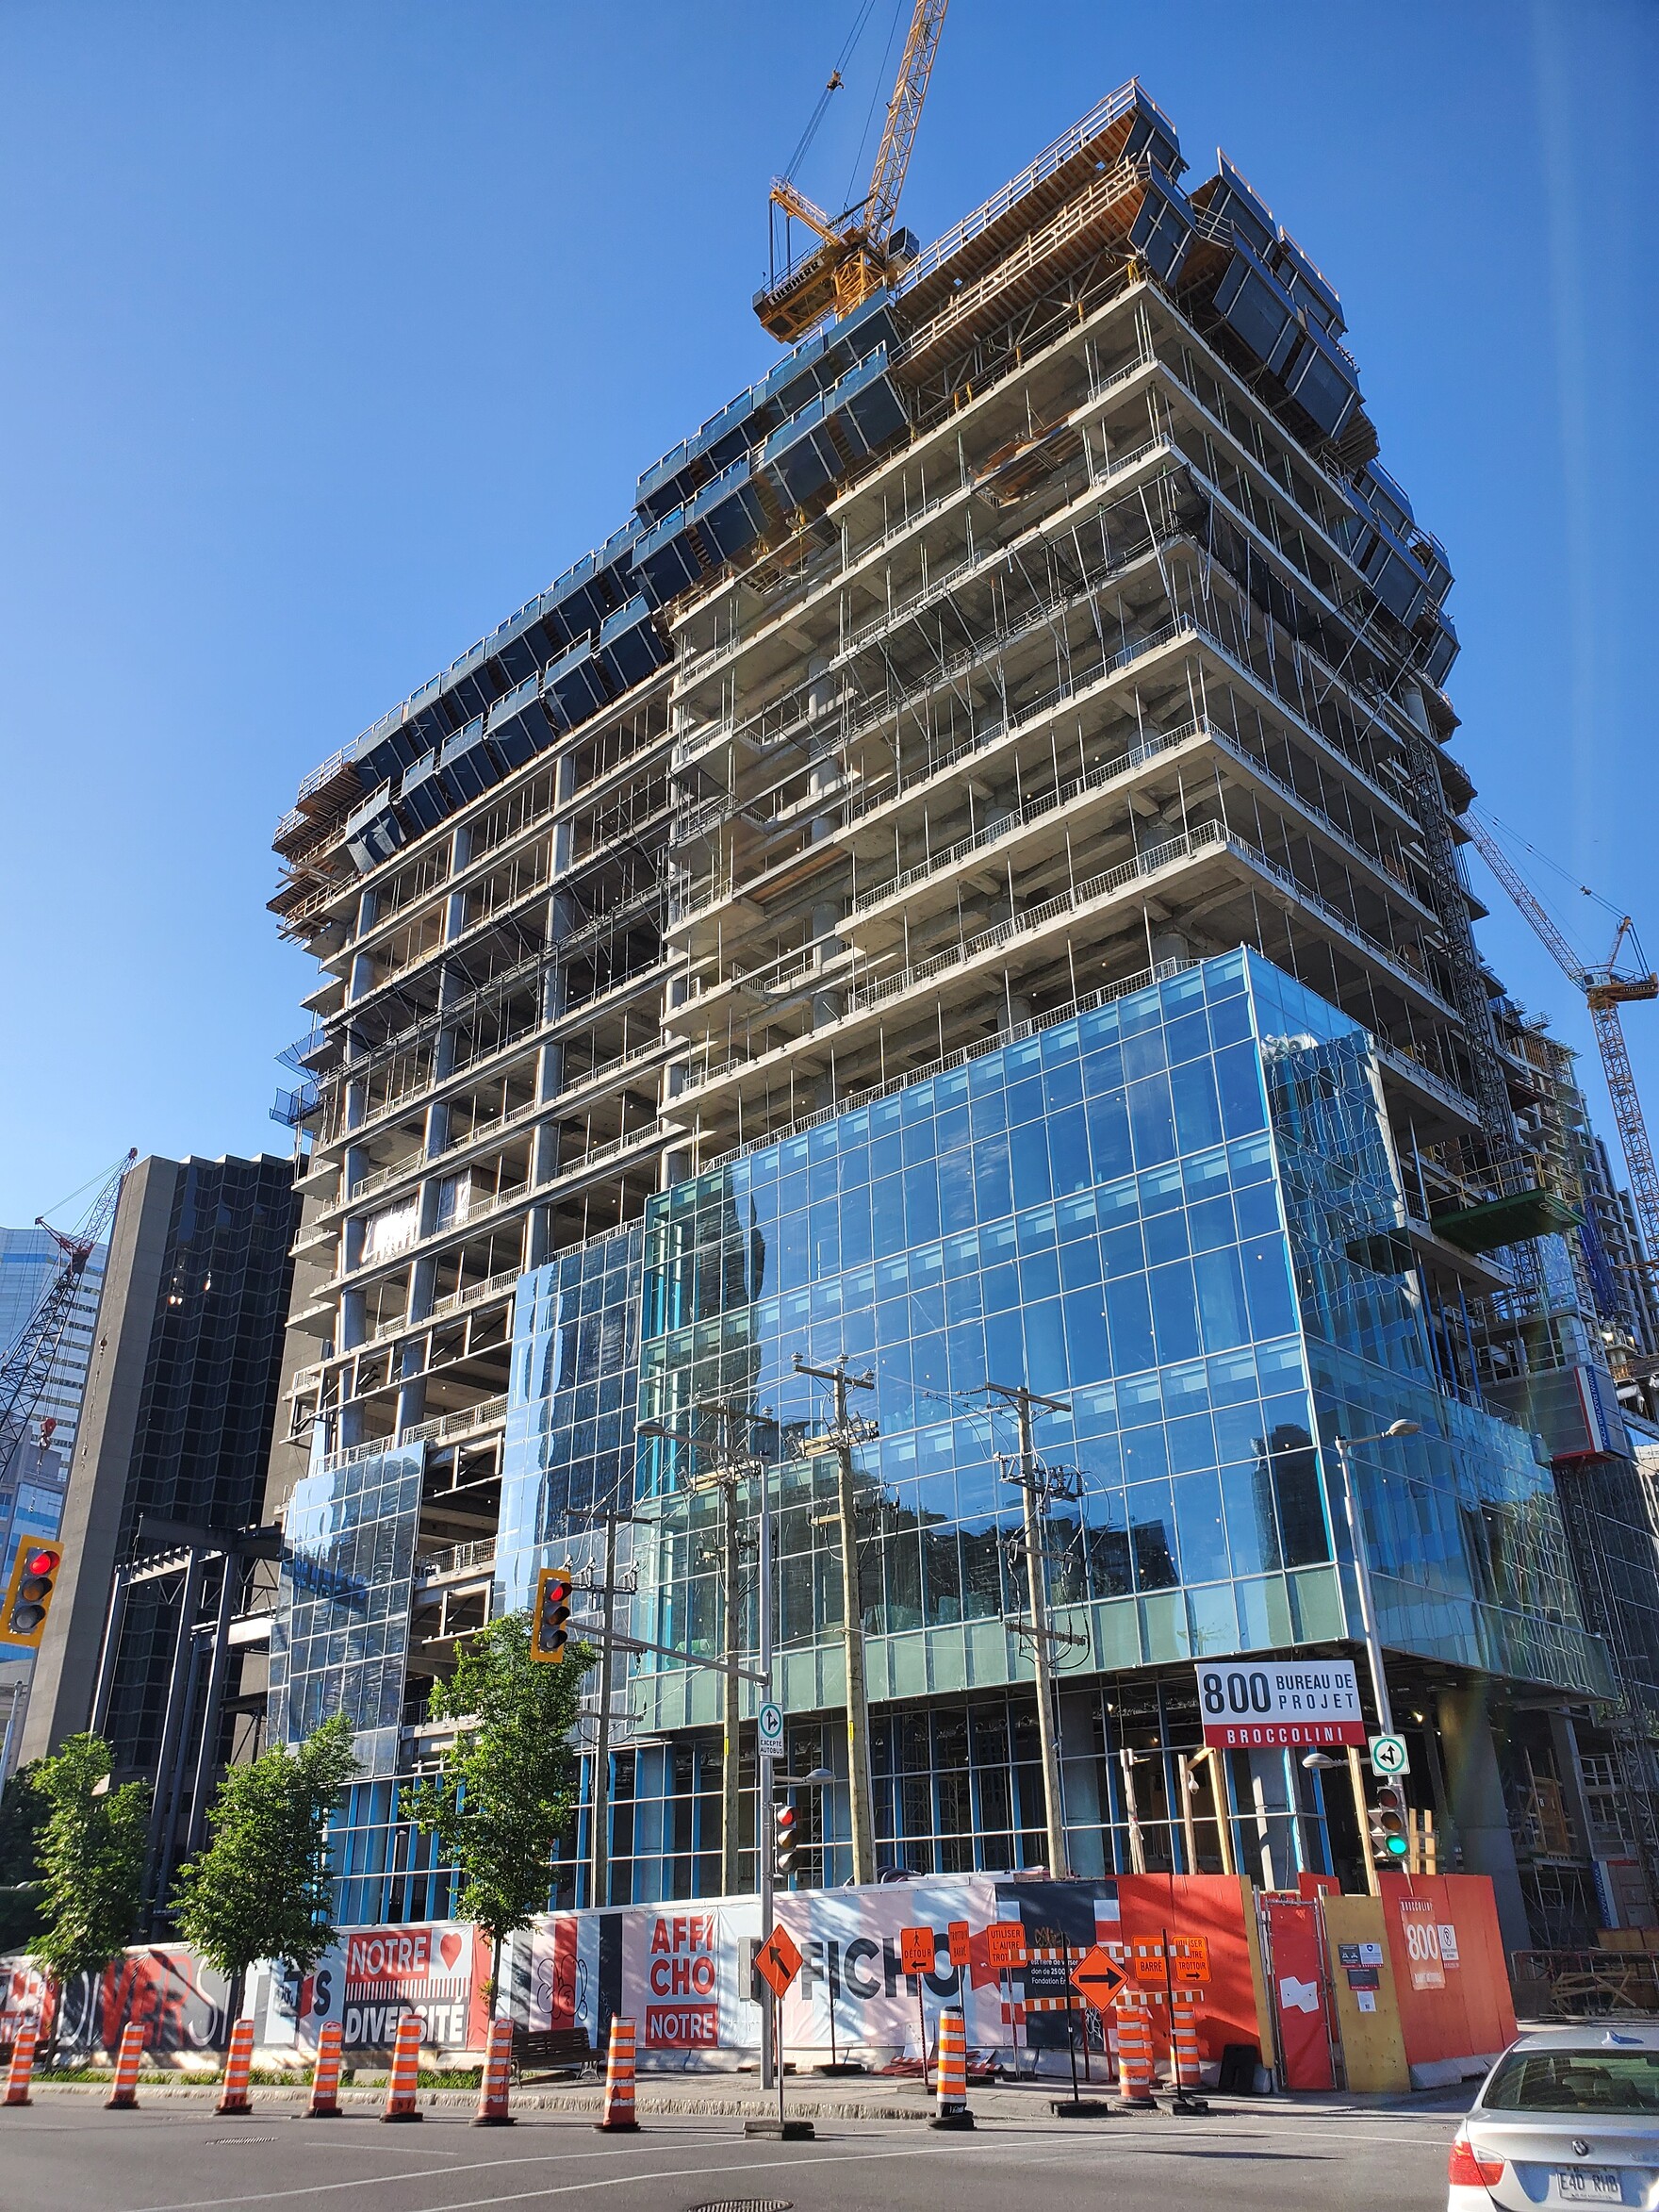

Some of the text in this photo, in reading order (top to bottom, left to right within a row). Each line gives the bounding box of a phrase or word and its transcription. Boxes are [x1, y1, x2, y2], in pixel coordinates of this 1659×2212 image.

[771, 260, 820, 303] LIEBHERR
[1275, 1674, 1354, 1690] BUREAU DE
[1203, 1672, 1272, 1714] 800
[1279, 1693, 1354, 1709] PROJET
[760, 1739, 782, 1747] EXCEPTÉ
[1227, 1726, 1343, 1744] BROCCOLINI
[760, 1746, 783, 1755] AUTOBUS
[650, 1915, 714, 1954] AFFI
[991, 1927, 1021, 1939] UTILISER
[1406, 1923, 1438, 1960] 800
[904, 1948, 932, 1958] DÉTOUR
[993, 1941, 1020, 1950] L'AUTRE
[350, 1936, 427, 1975] NOTRE
[1140, 1959, 1163, 1972] BARRÉ
[649, 1956, 715, 1996] CHO
[1031, 1976, 1059, 1985] Fondation
[345, 1996, 465, 2044] DIVESITÉ
[650, 2013, 714, 2039] NOTRE
